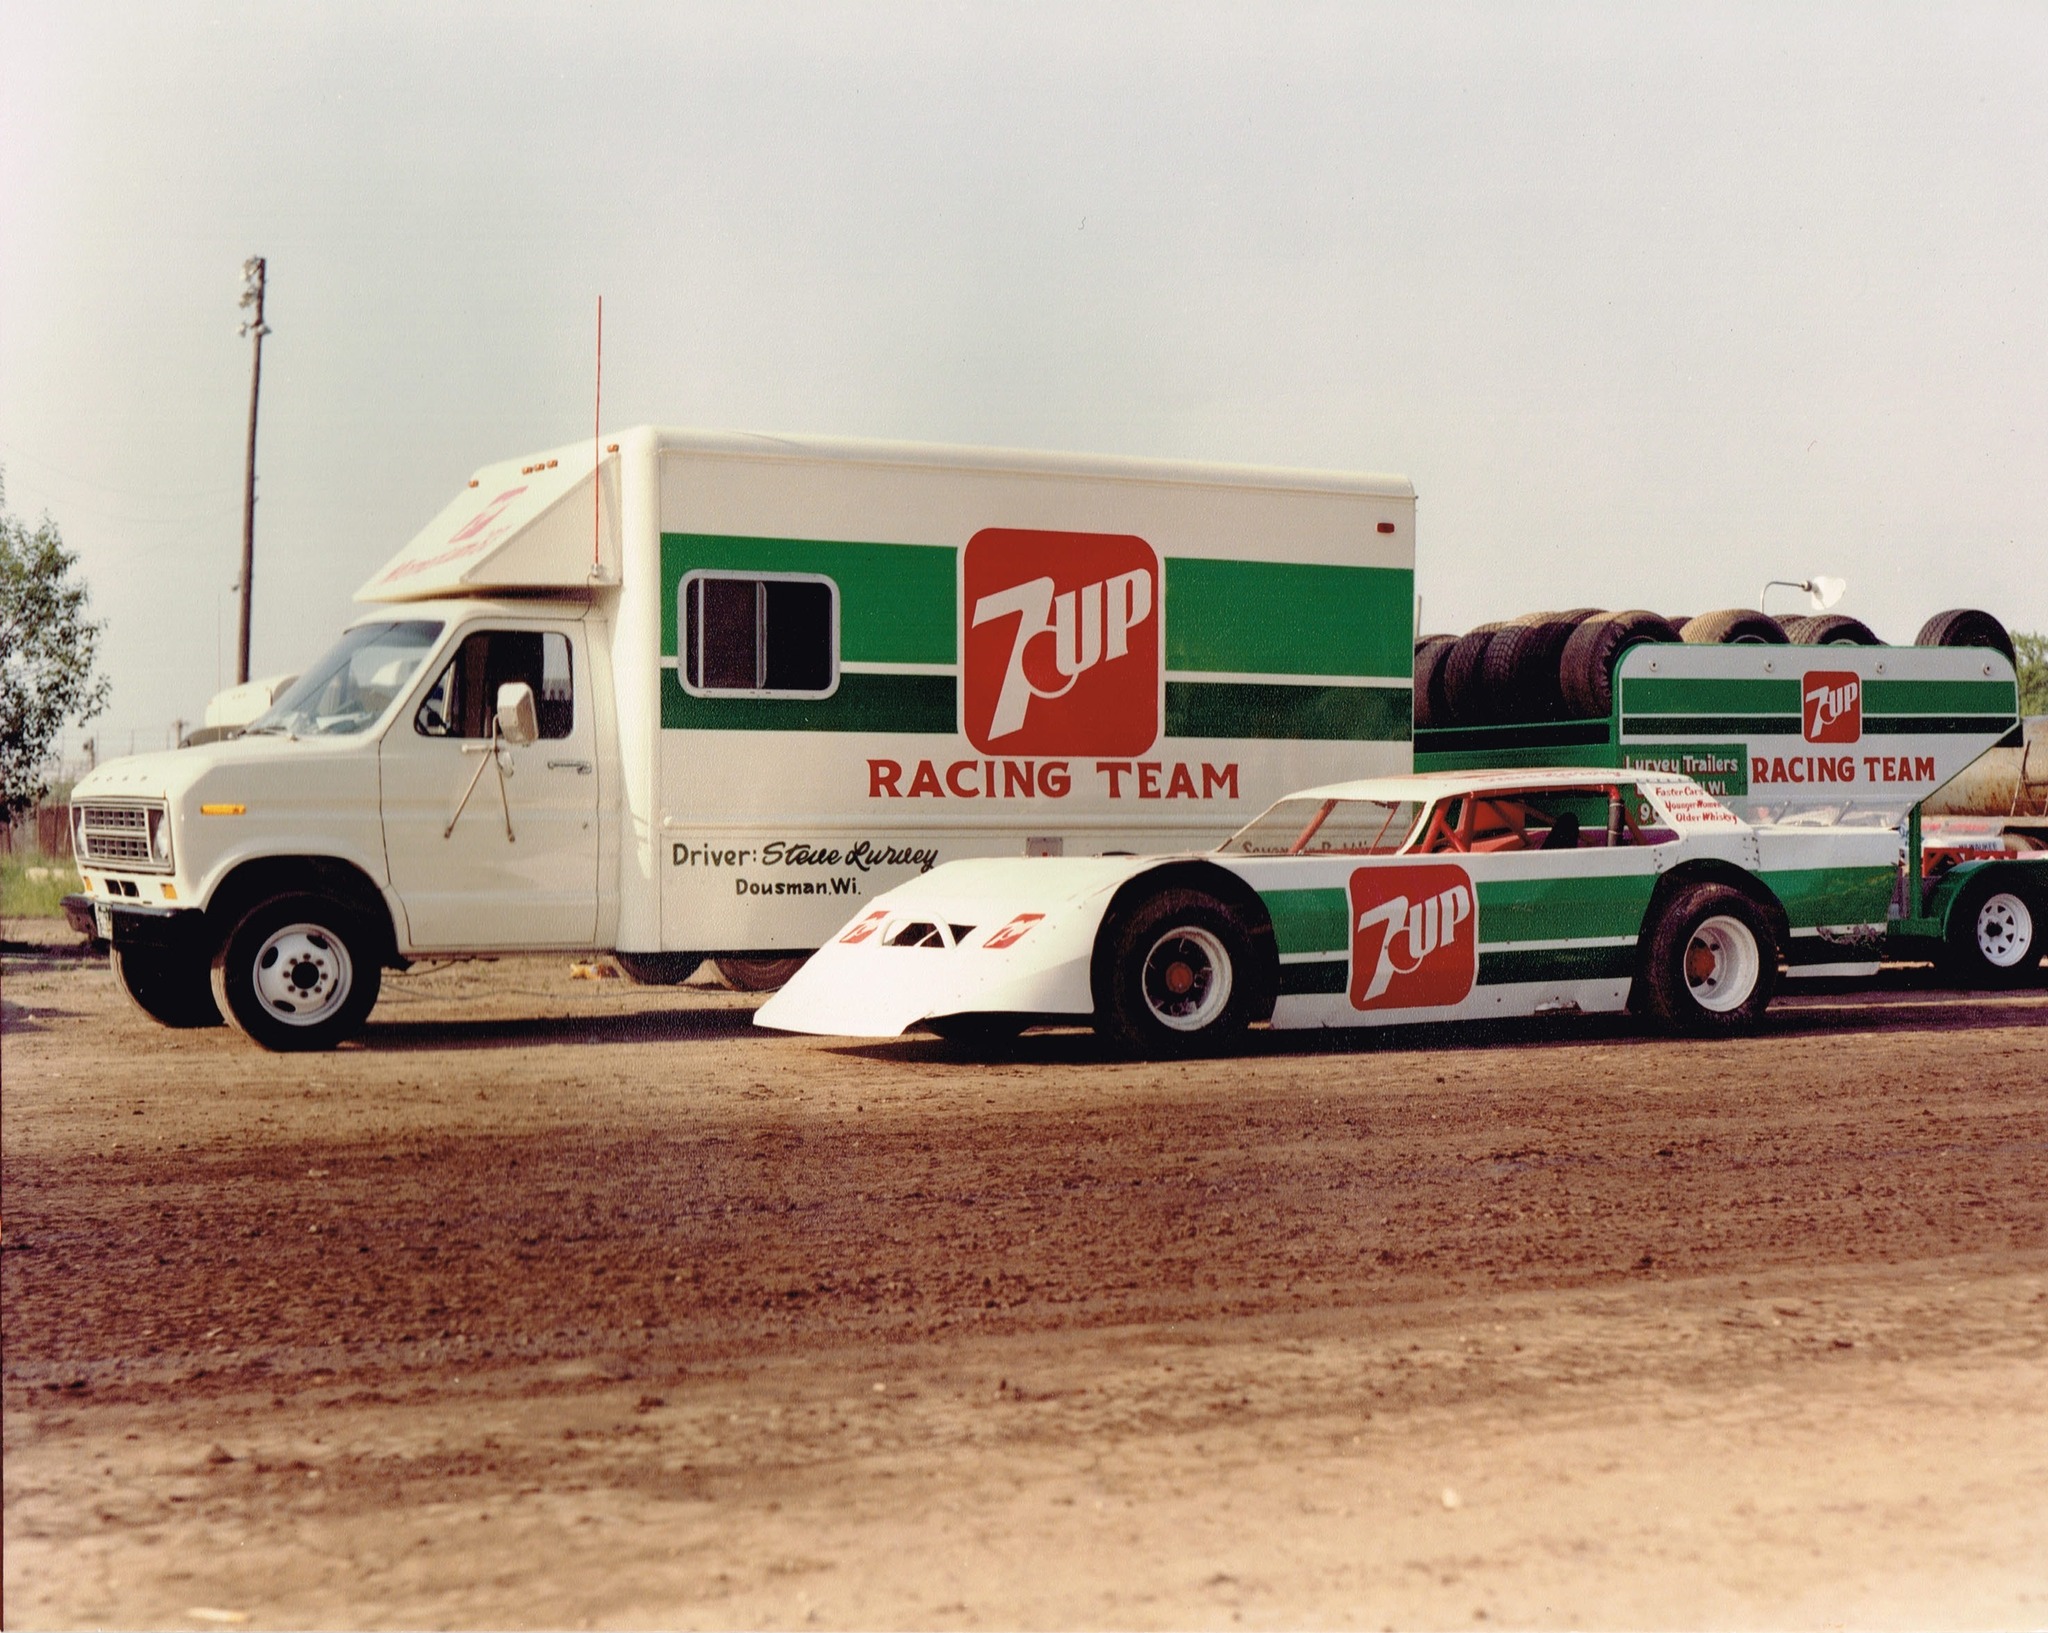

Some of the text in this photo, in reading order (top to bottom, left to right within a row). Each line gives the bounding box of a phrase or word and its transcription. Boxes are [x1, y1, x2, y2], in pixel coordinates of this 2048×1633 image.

[971, 568, 1151, 741] 7UP
[1806, 682, 1858, 738] 7UP
[1682, 754, 1738, 773] Trailers
[1751, 757, 1935, 783] RACING TEAM
[867, 760, 1239, 799] RACING TEAM
[1656, 787, 1683, 796] Faster
[1684, 786, 1704, 796] Cars
[1665, 800, 1722, 812] Younger Women
[1676, 812, 1699, 822] Older
[672, 840, 938, 873] Driver: Steve Lurvey
[1358, 885, 1470, 1002] 7UP
